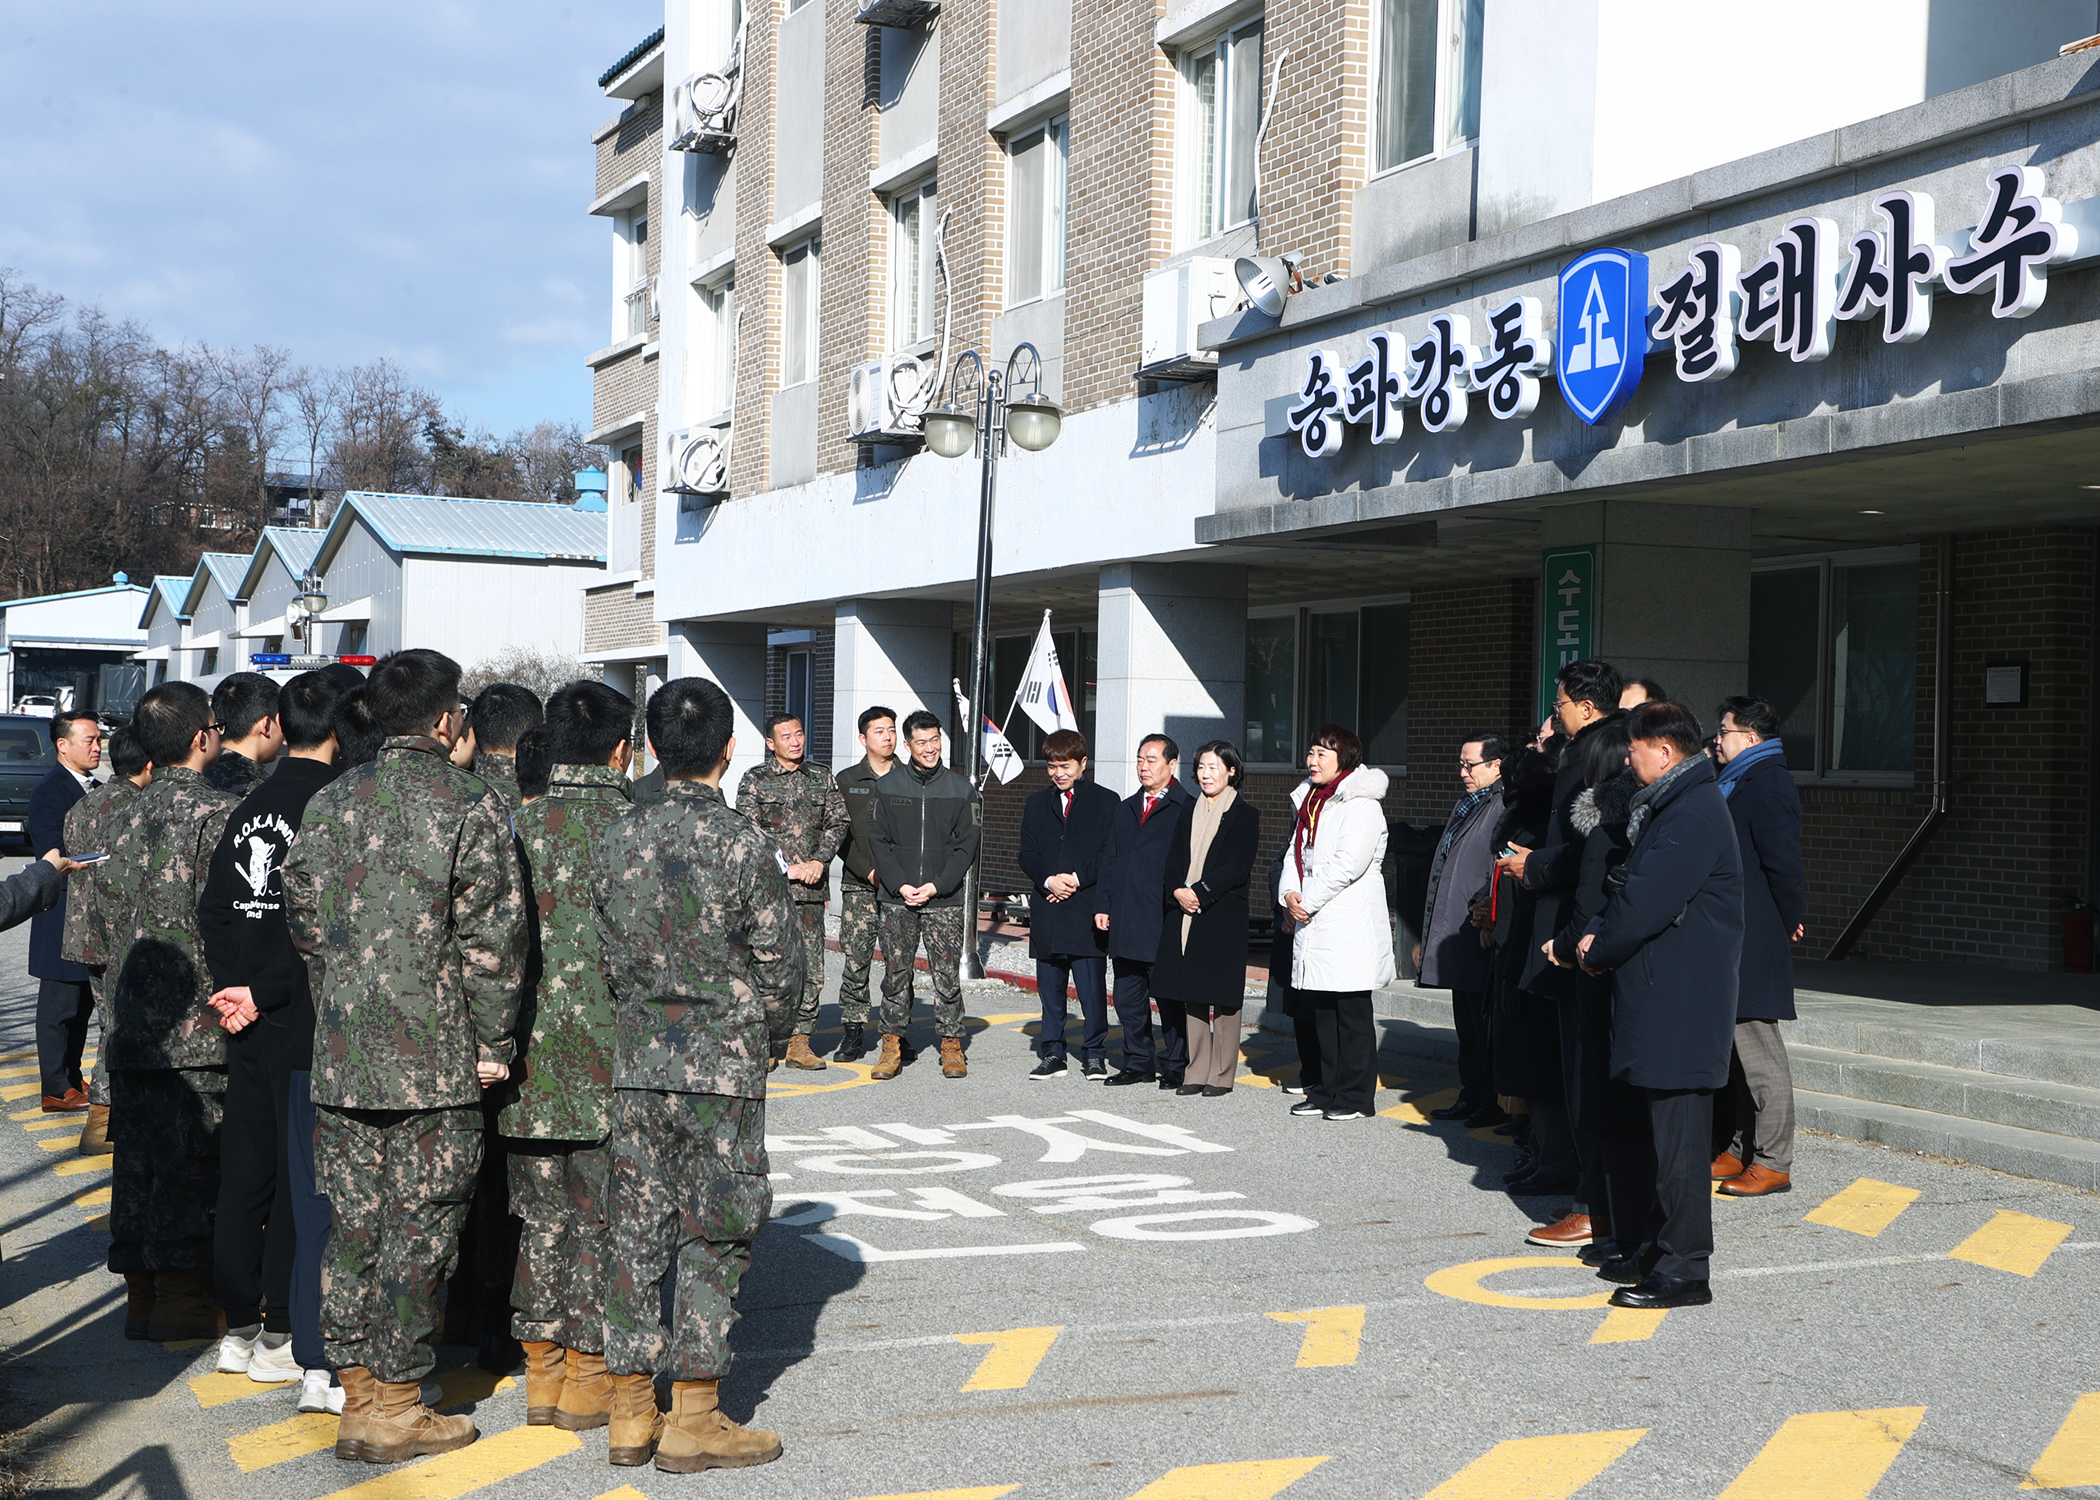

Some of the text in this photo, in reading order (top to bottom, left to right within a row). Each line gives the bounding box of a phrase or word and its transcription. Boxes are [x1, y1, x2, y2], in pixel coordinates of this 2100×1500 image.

[1287, 168, 2058, 455] 송파강동 절대사수
[767, 1174, 1320, 1262] 전용
